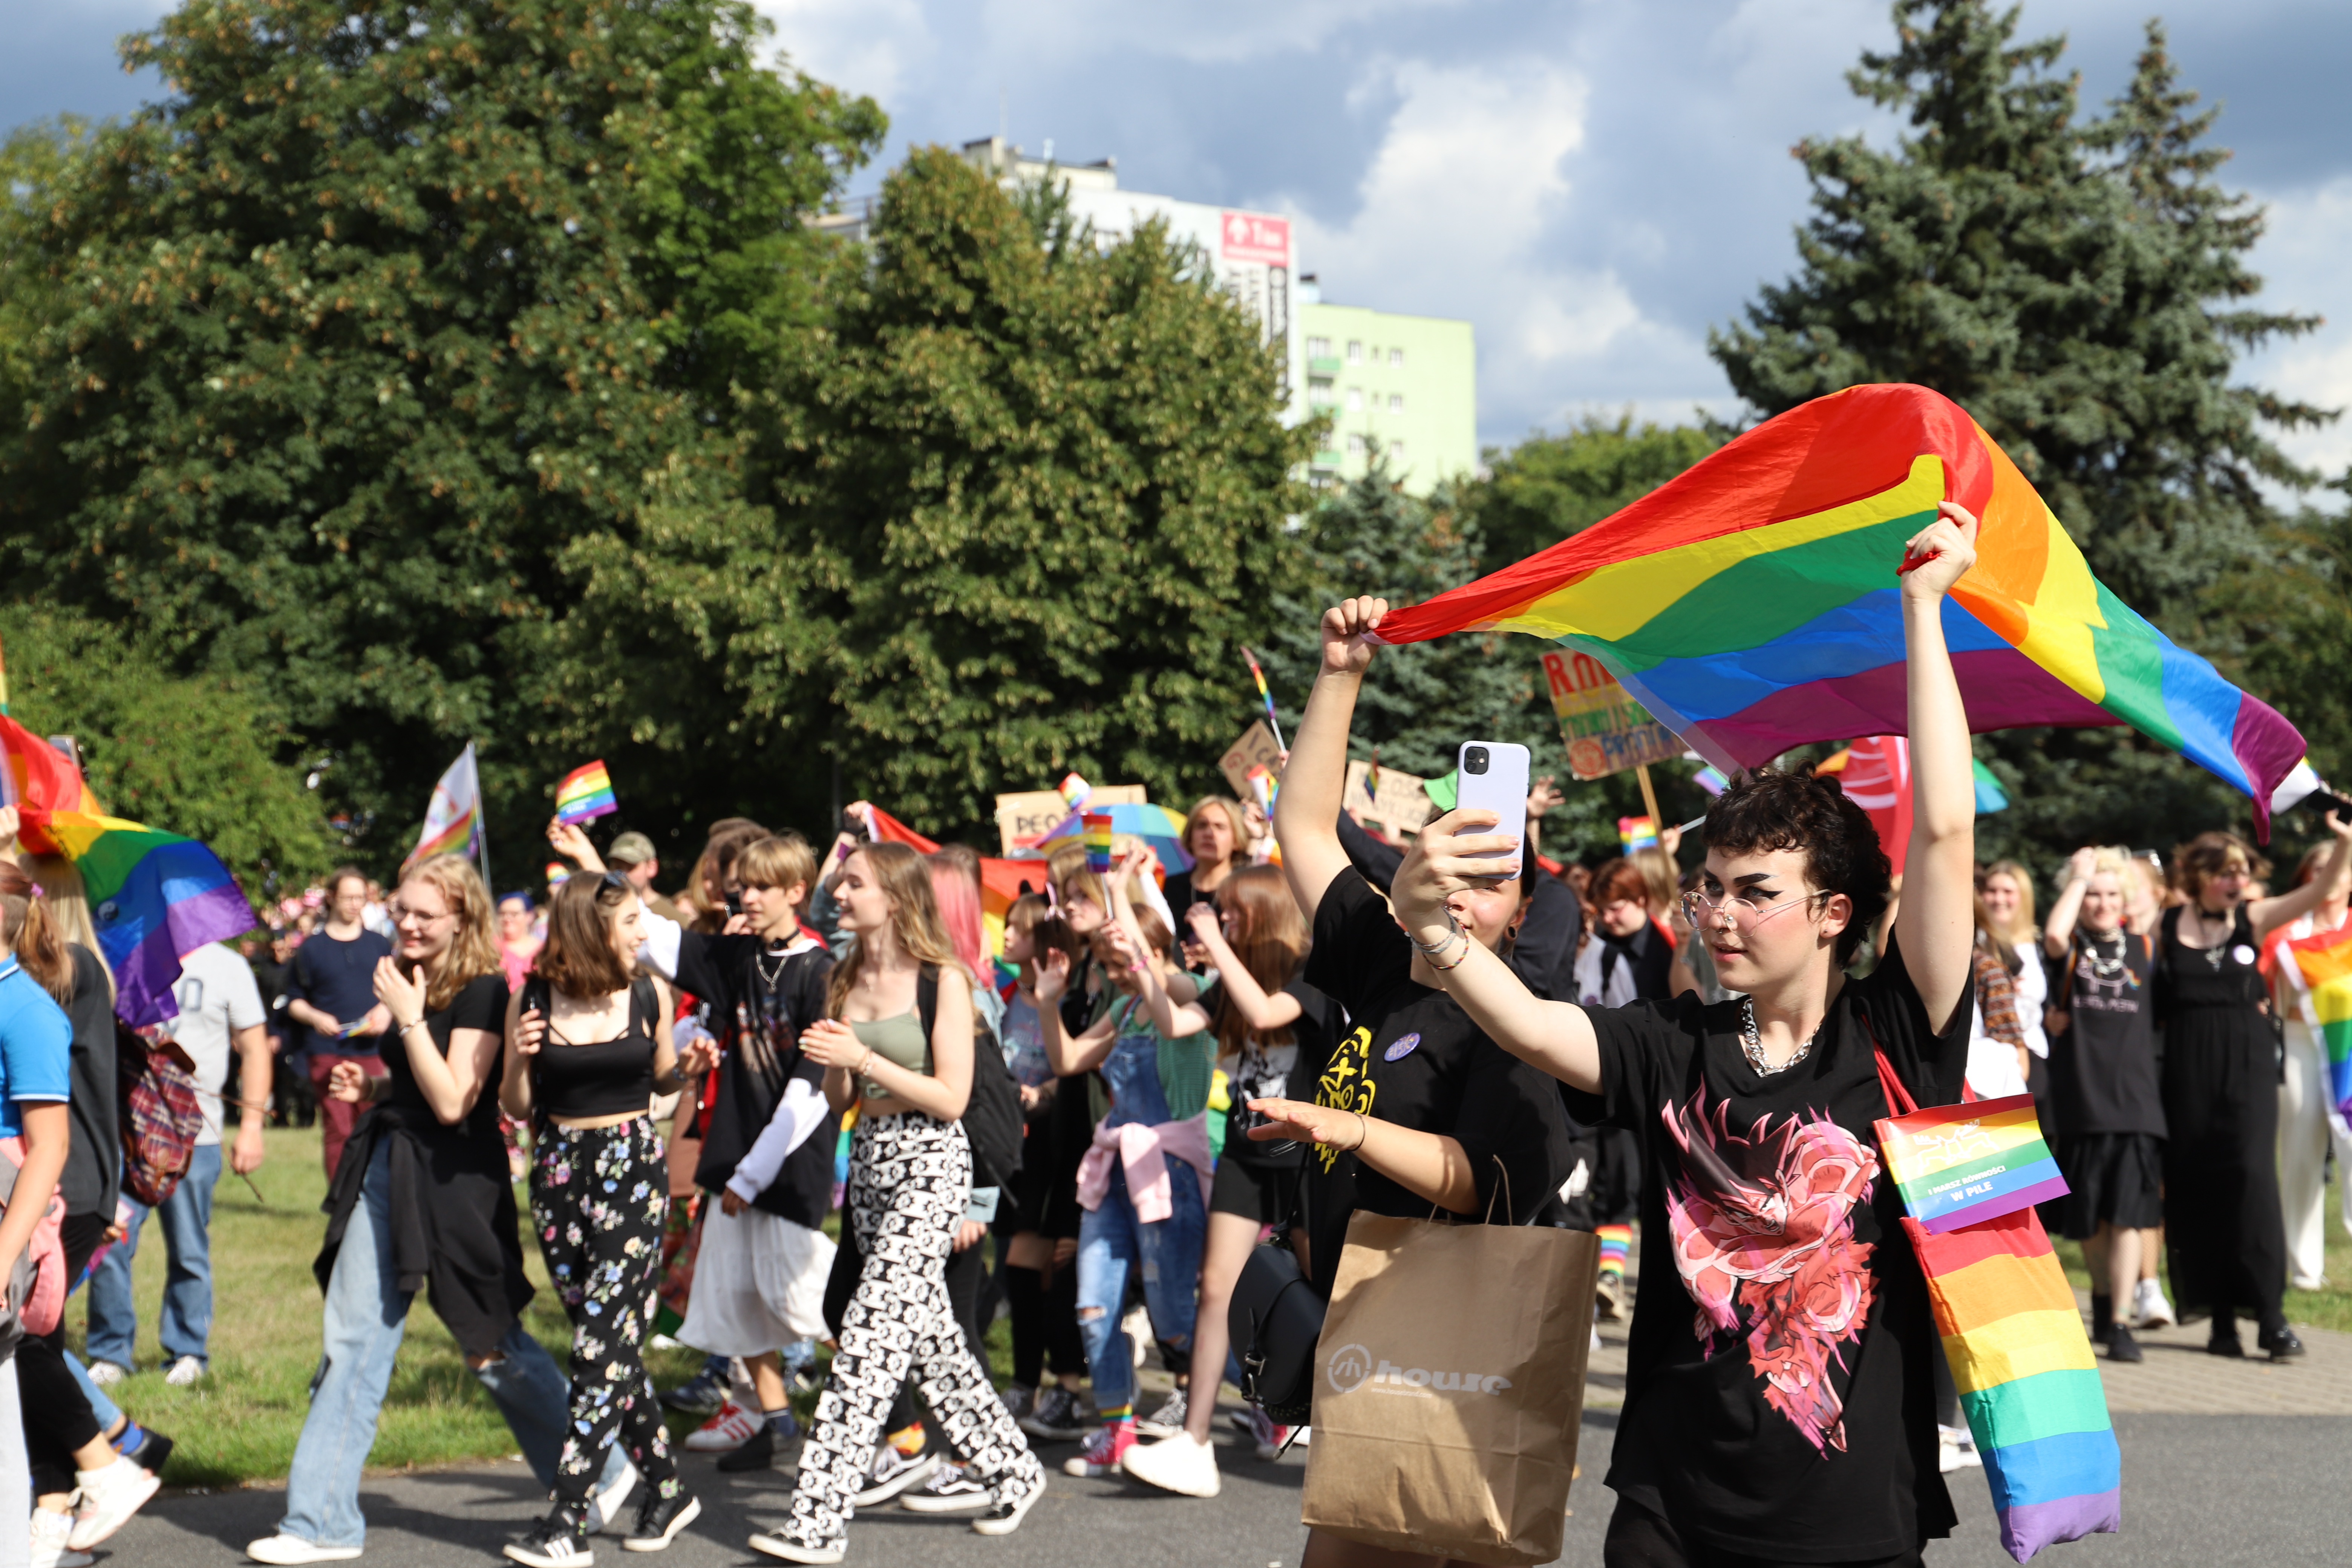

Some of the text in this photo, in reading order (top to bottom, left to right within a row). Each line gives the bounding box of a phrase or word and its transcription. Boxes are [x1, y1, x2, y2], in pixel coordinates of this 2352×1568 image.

[1932, 1179, 1962, 1195] MARSZ
[1962, 1165, 2006, 1185] RÓWNOŚCI
[1951, 1181, 1994, 1202] W PILE
[1373, 1360, 1513, 1396] house
